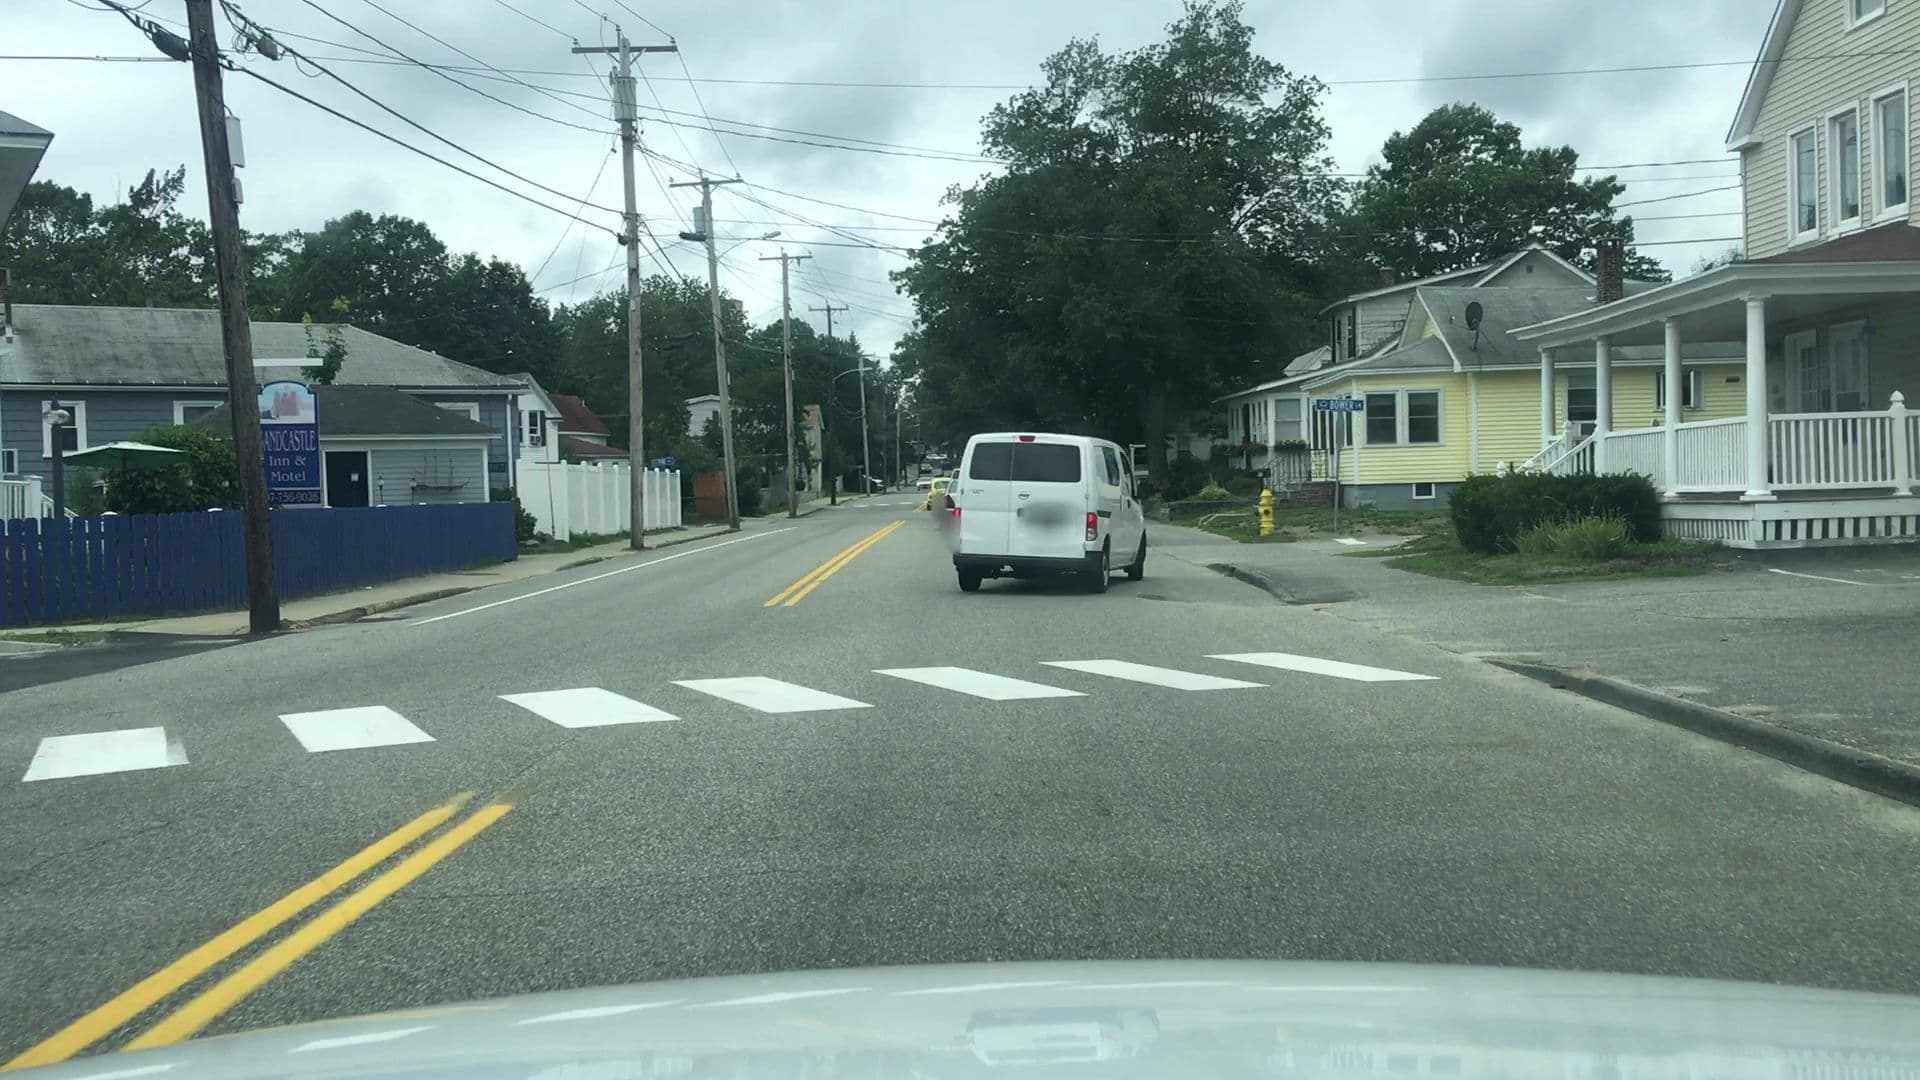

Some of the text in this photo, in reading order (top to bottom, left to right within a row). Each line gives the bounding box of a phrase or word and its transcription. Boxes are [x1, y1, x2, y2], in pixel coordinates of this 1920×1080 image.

[1330, 400, 1353, 410] BOWER
[264, 430, 316, 452] ANDCASTLE
[269, 455, 306, 466] Inn &
[271, 470, 306, 482] Motel
